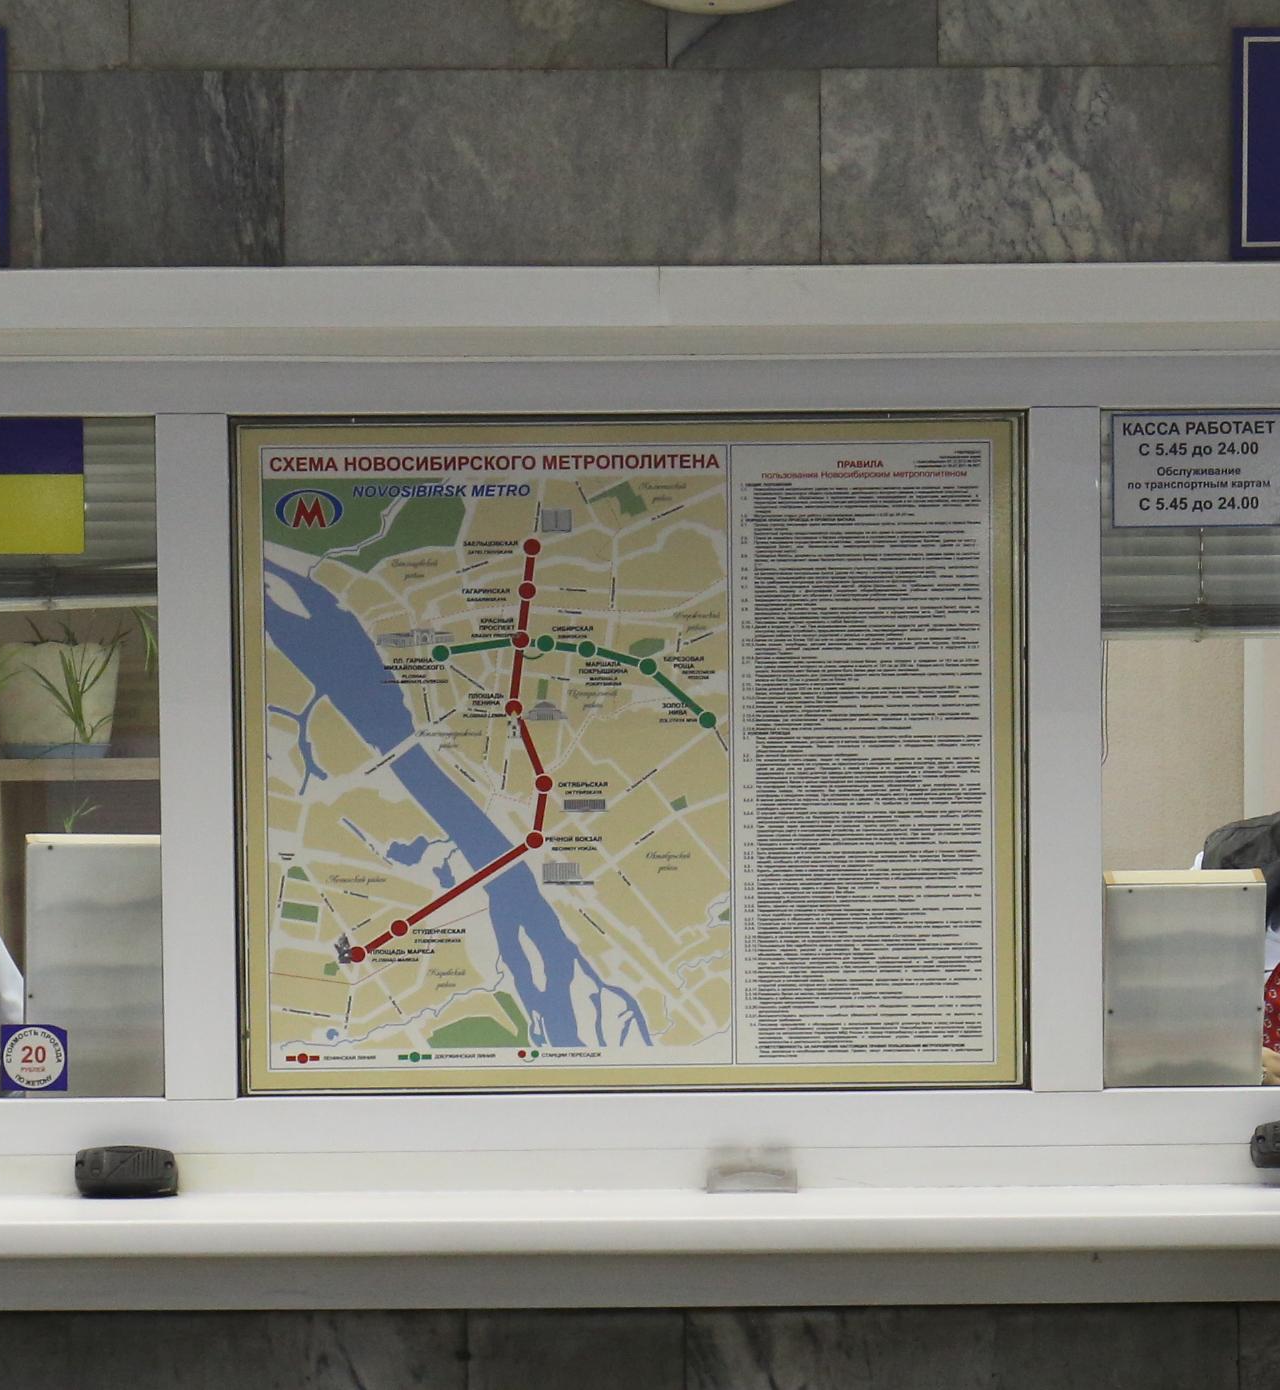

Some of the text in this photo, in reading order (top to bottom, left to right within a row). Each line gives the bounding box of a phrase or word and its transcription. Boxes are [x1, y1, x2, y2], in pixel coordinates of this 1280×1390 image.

[1123, 421, 1275, 436] КАССА РАБОТАЕТ
[1139, 442, 1259, 457] С 5.45 до 24.00
[269, 453, 719, 473] СХЕМА НОВОСИБИРСКОГО МЕТРОПОЛИТЕНА
[837, 460, 884, 469] ПРАВИЛА
[761, 470, 968, 479] пользования Новосибирским метрополитеном
[1157, 466, 1241, 478] Обслуживание
[352, 483, 531, 498] NOVOSIBIRSK METRO
[1128, 480, 1271, 491] по транспортным картам
[1139, 497, 1259, 512] С 5.45 до 24.00
[6, 1030, 39, 1063] СТОИМОСТЬ
[21, 1045, 46, 1063] 20
